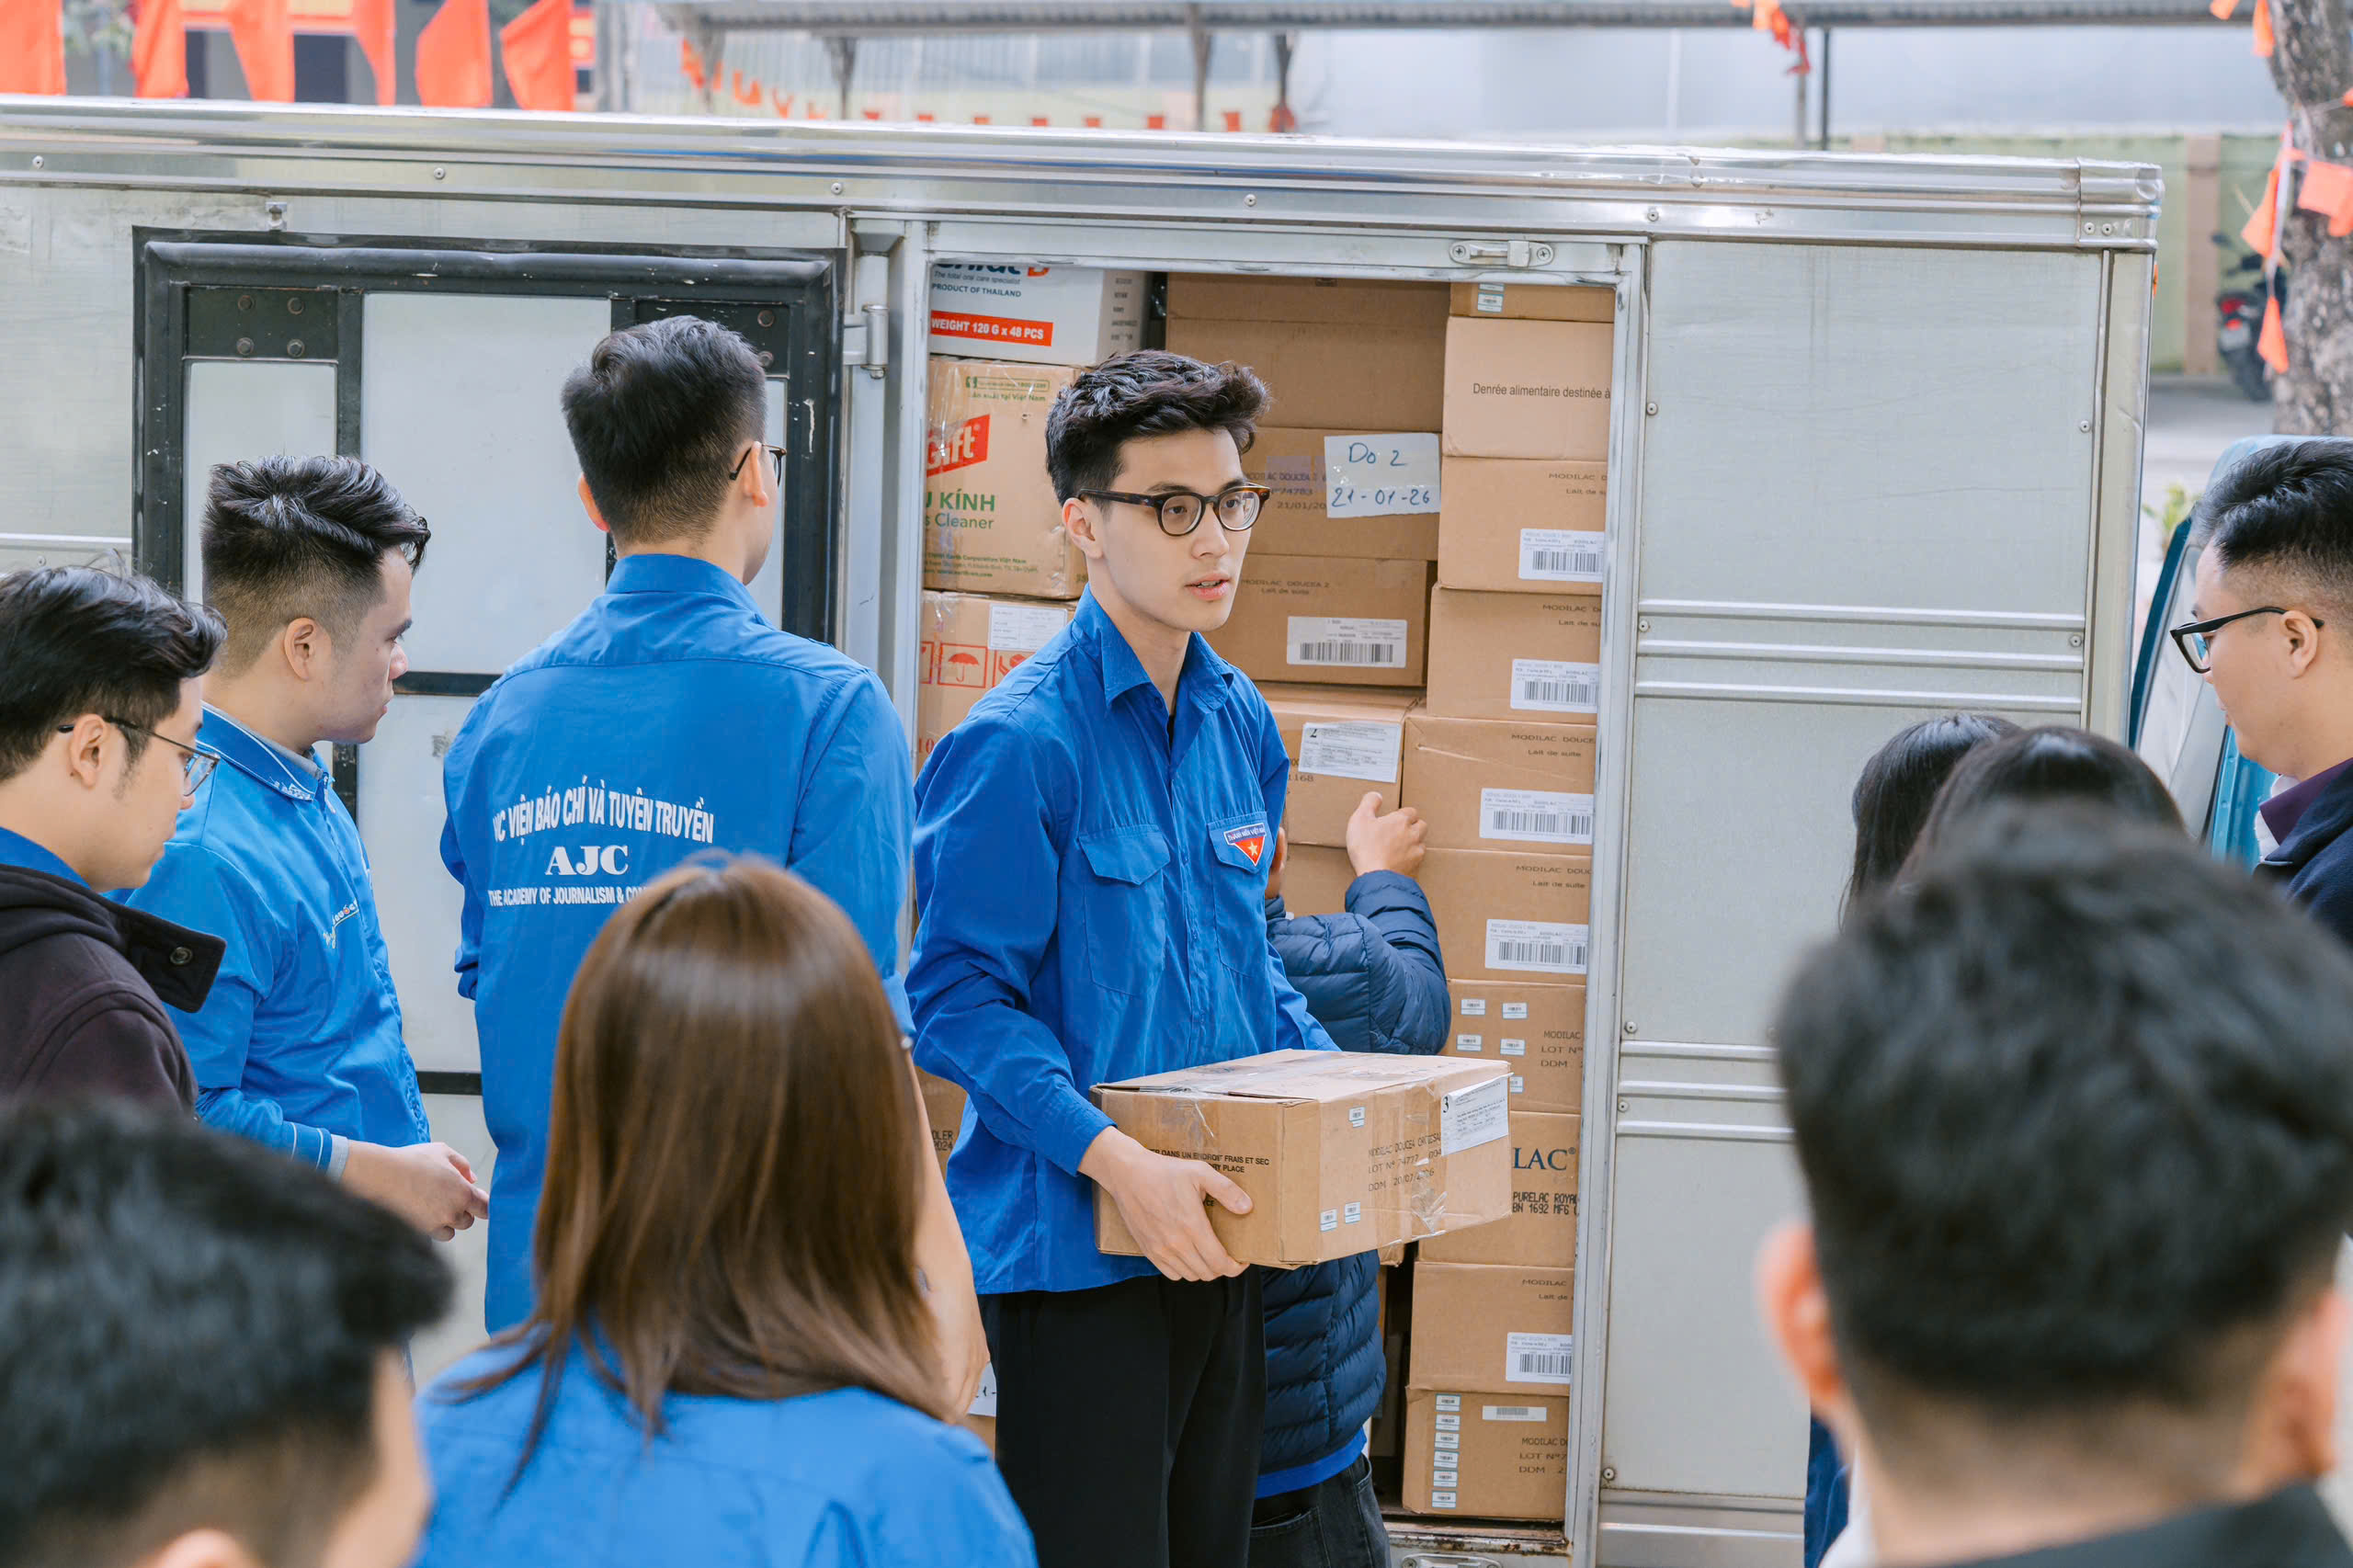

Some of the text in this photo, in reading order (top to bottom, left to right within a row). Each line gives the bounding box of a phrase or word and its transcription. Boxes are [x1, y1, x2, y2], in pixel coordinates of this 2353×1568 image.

[932, 283, 1022, 298] PRODUCT OF THAILAND
[931, 318, 971, 332] WEIGHT
[972, 322, 990, 335] 120
[991, 324, 1000, 335] G
[1009, 326, 1022, 338] 48
[1023, 328, 1044, 340] PCS
[1472, 382, 1507, 395] Denrée
[1509, 384, 1561, 397] alimentaire
[1563, 386, 1602, 399] destinée
[1390, 449, 1409, 467] 2
[1548, 472, 1596, 481] MODILAC
[940, 488, 995, 512] KÍNH
[935, 513, 995, 529] Cleaner
[1542, 604, 1587, 612] MODILAC
[1511, 733, 1597, 744] MODILAC DOUCE
[507, 793, 534, 846] VIỆN
[535, 784, 561, 832] BÁO
[563, 774, 588, 826] CHÍ
[588, 778, 606, 825] VÀ
[608, 786, 654, 832] TUYÊN
[655, 796, 715, 844] TRUYỀN
[545, 844, 630, 876] AJC
[1516, 865, 1563, 873] MODILAC
[488, 890, 504, 907] THE
[505, 886, 538, 906] ACADEMY
[539, 886, 552, 904] OF
[552, 885, 616, 905] JOURNALISM
[617, 886, 625, 903] &
[1543, 1030, 1581, 1040] MODILAC
[1540, 1046, 1563, 1054] LOT
[1442, 1096, 1449, 1113] 3
[1161, 1150, 1180, 1158] DANS
[1182, 1151, 1191, 1159] UN
[1224, 1154, 1244, 1164] FRAIS
[1256, 1158, 1269, 1166] SEC
[1223, 1165, 1245, 1173] PLACE
[1369, 1163, 1383, 1174] LOT
[1513, 1191, 1550, 1203] PURELAC
[1512, 1202, 1523, 1213] BN
[1529, 1203, 1549, 1214] 1692
[1553, 1204, 1569, 1215] MFG
[1522, 1278, 1567, 1287] MODILAC
[1521, 1437, 1559, 1447] MODILAC
[1519, 1452, 1542, 1460] LOT
